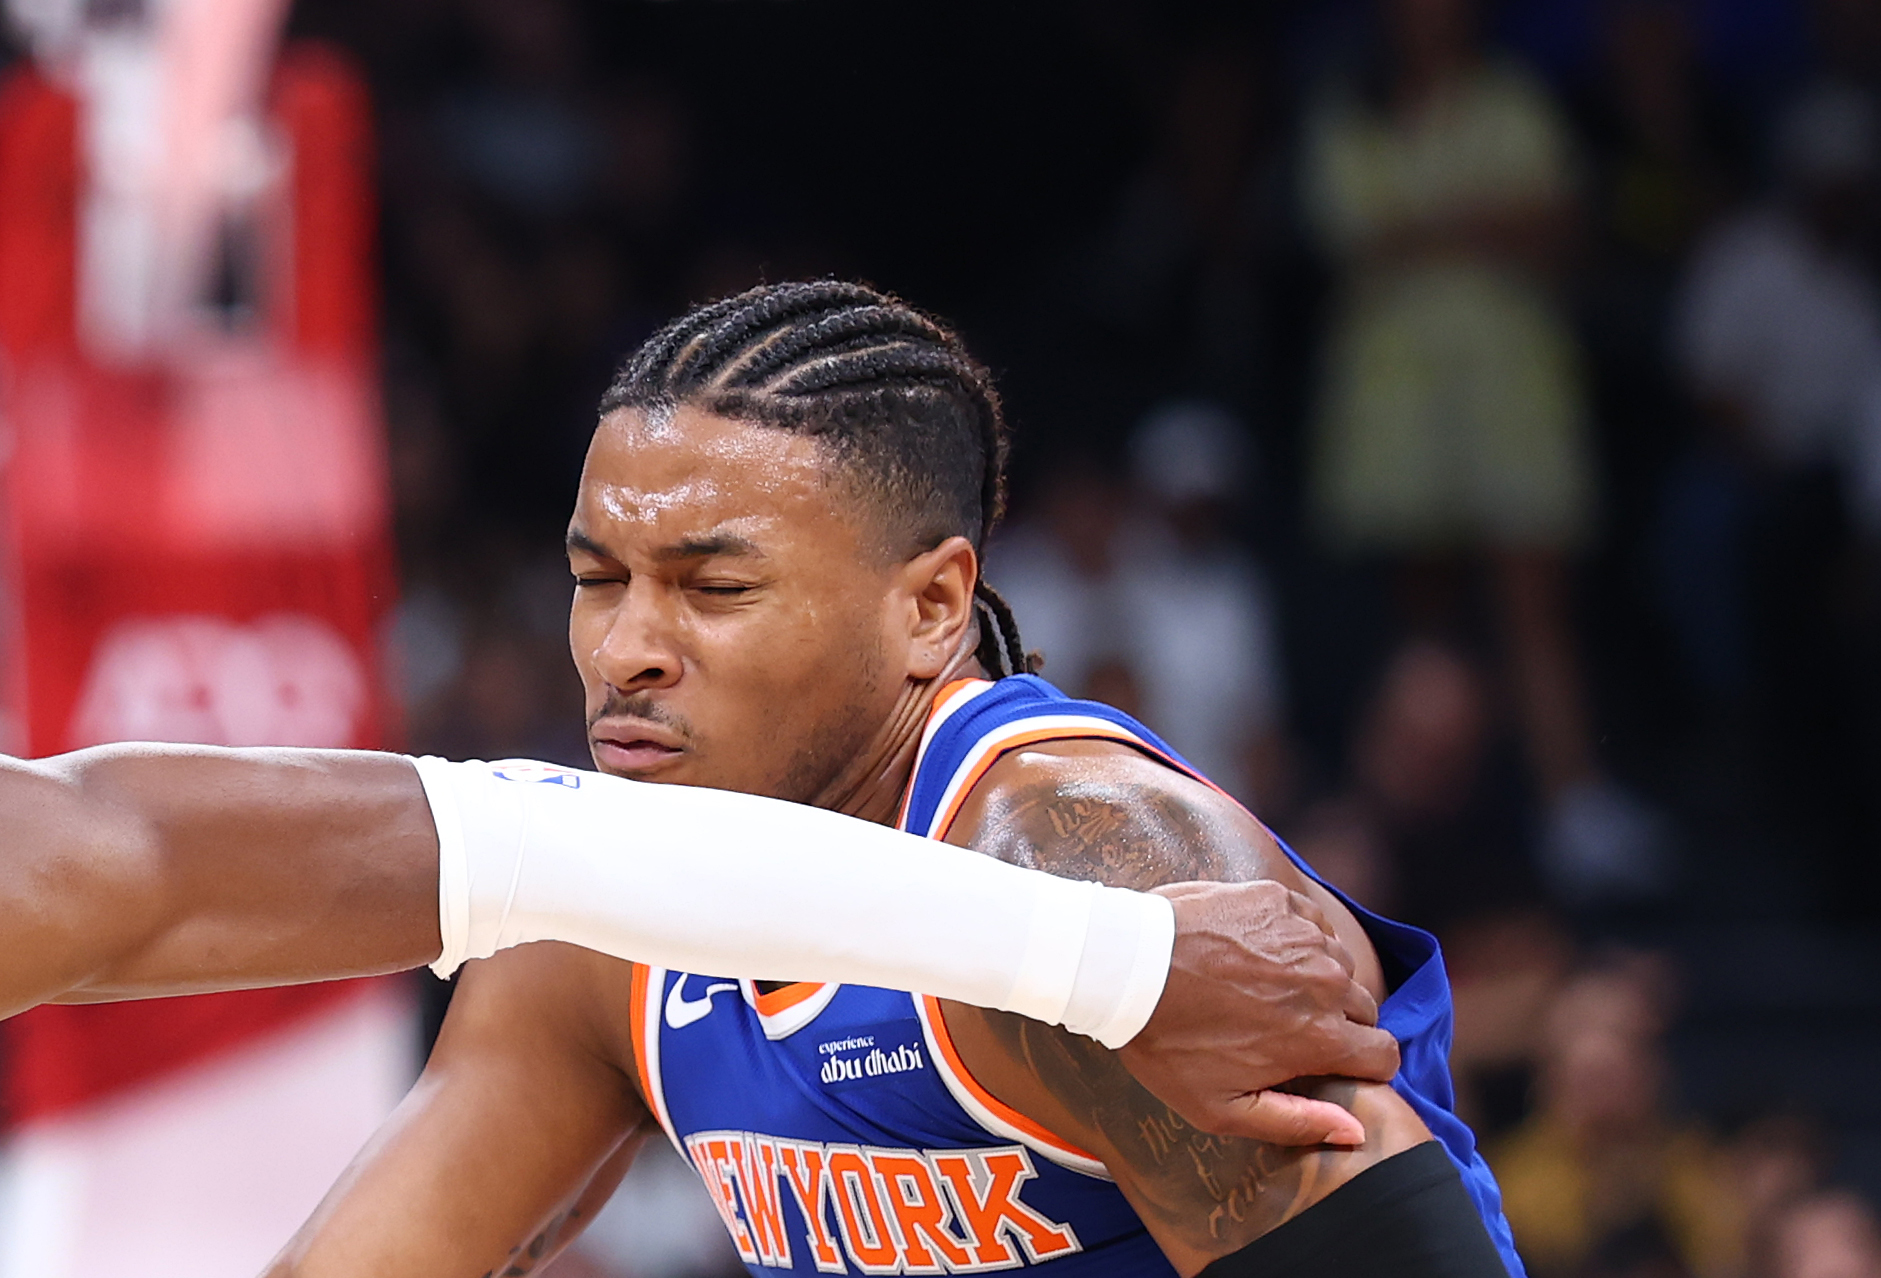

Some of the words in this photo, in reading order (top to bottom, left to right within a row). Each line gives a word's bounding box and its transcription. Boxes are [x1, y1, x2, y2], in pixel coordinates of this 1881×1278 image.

[818, 1035, 875, 1055] experience
[820, 1055, 863, 1084] abu
[864, 1042, 924, 1077] dhabi
